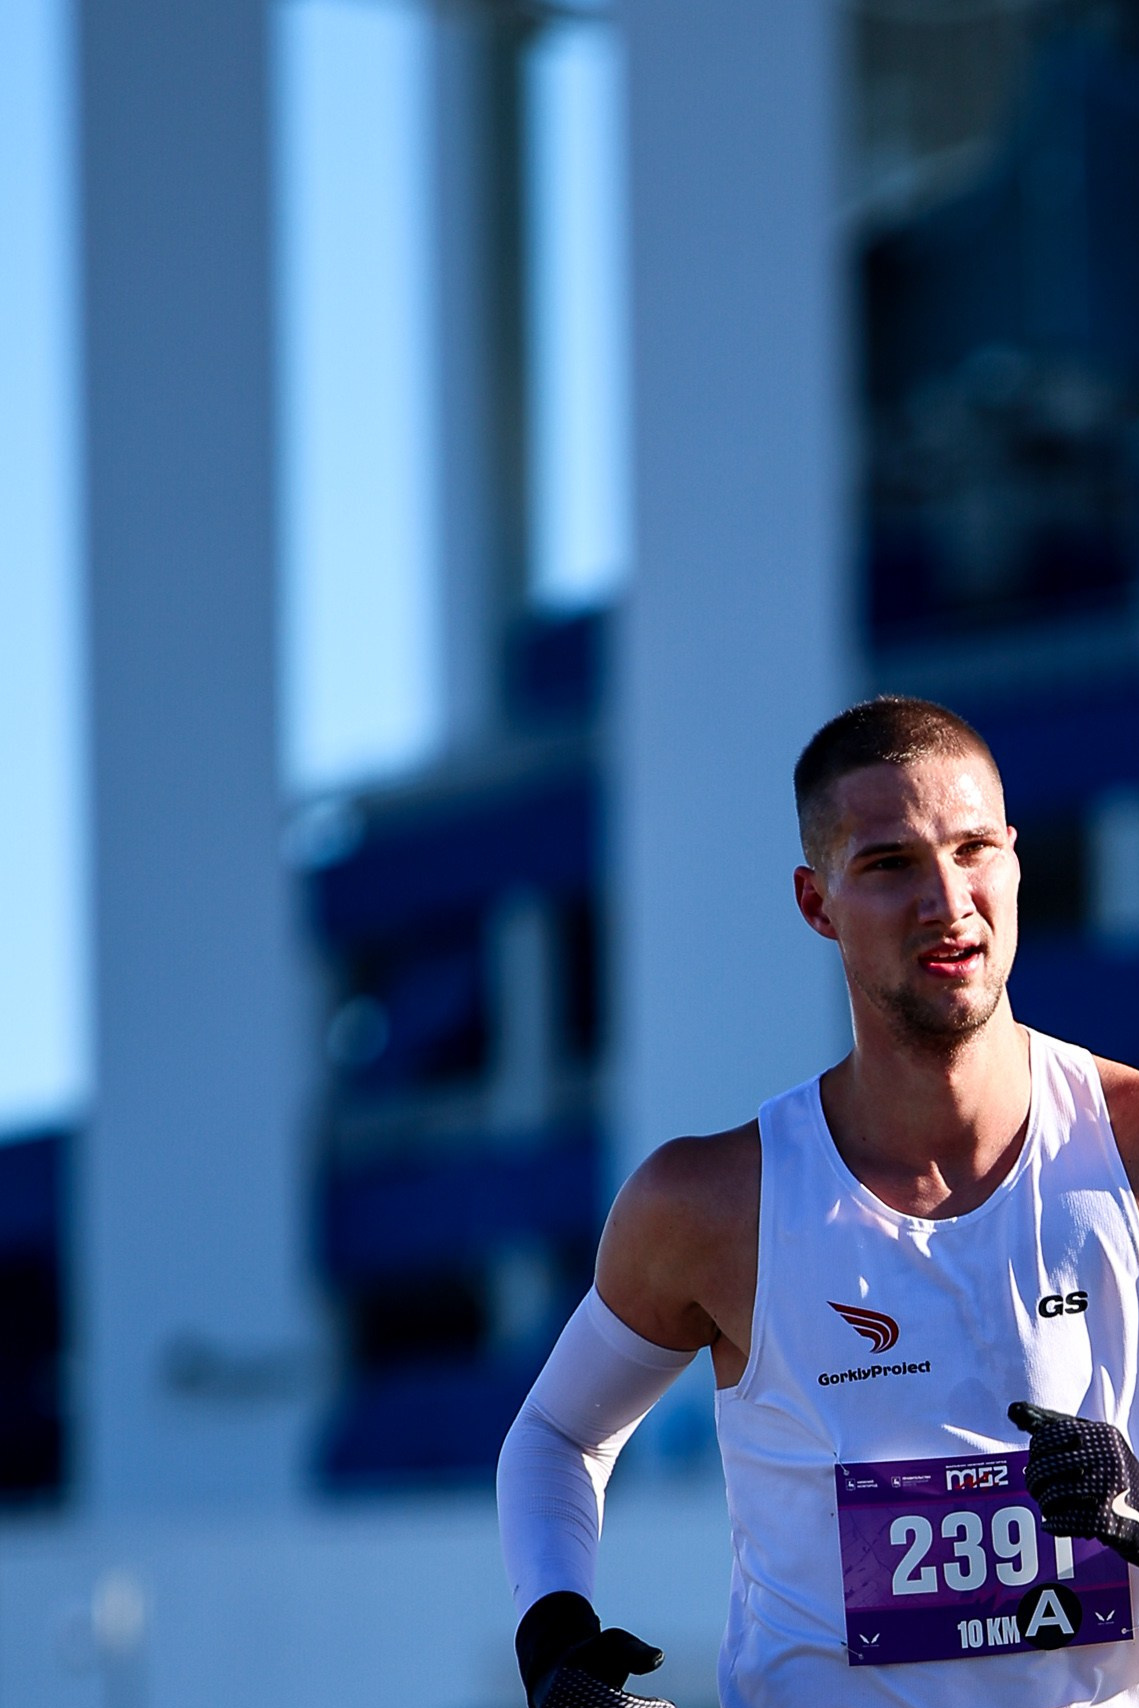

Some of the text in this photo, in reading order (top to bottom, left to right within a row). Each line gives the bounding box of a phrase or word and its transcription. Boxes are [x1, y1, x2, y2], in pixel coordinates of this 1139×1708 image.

[1038, 1290, 1089, 1319] GS
[1024, 1589, 1075, 1638] A
[957, 1615, 1021, 1650] 10 KM
